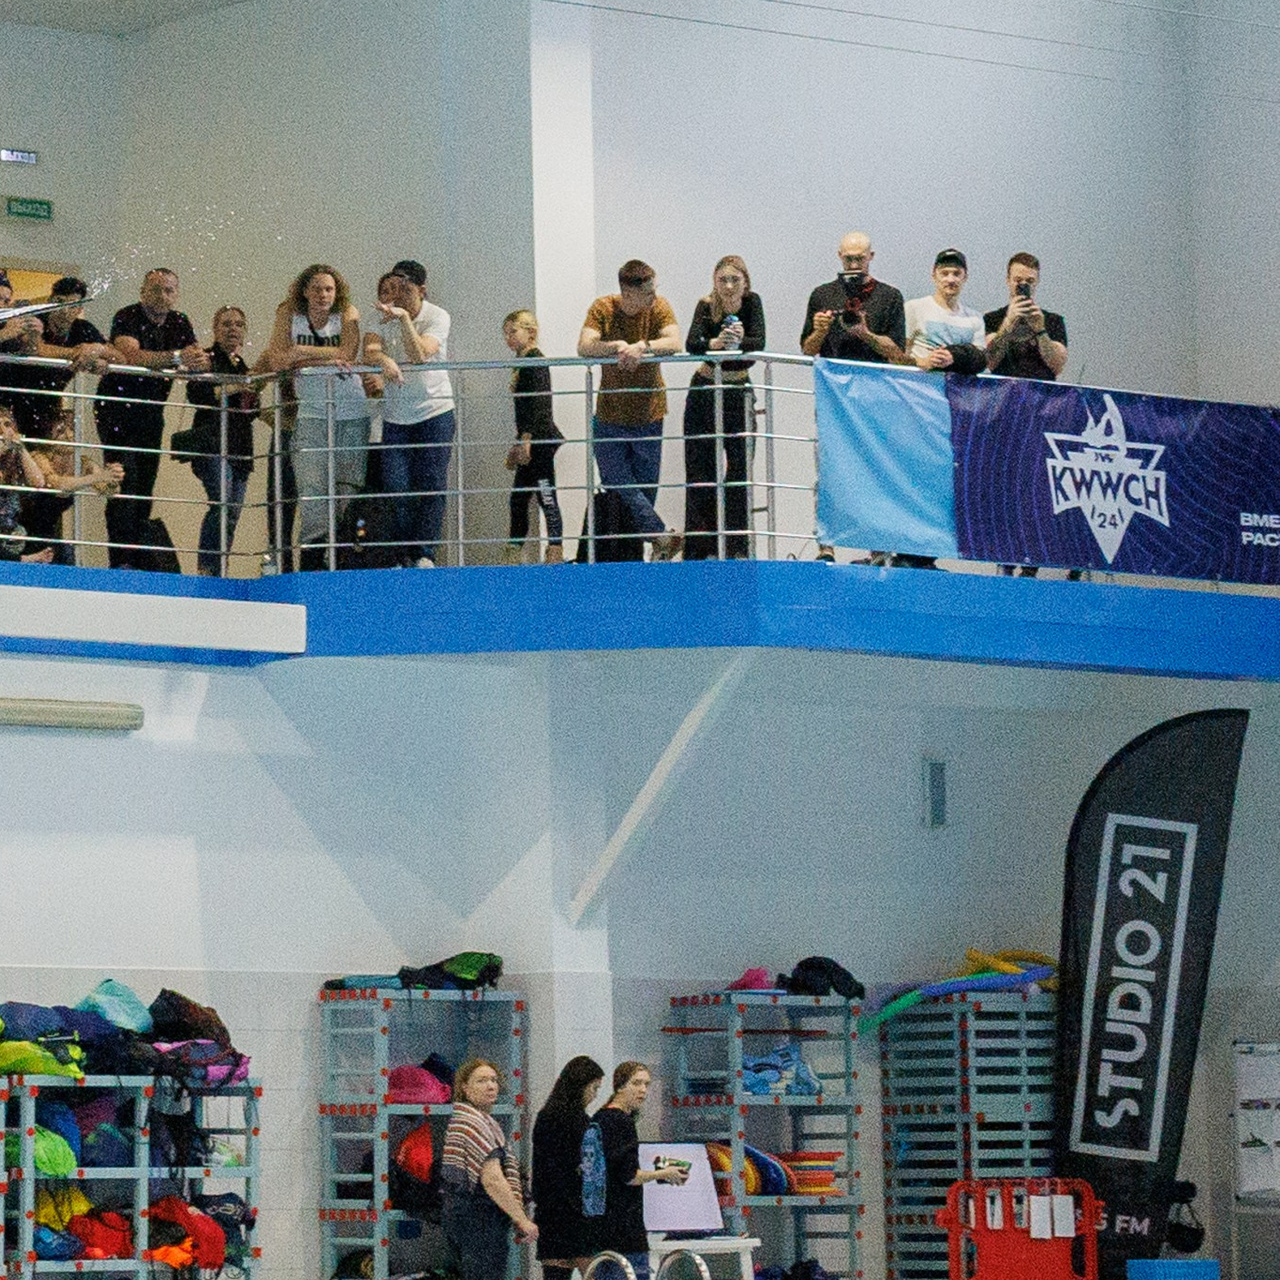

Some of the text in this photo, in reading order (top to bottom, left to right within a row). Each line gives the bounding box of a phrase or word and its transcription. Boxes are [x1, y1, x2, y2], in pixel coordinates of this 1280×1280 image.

[1051, 464, 1164, 518] KWWCH
[1093, 842, 1172, 1129] STUDIO 21
[1115, 1214, 1150, 1236] FM
